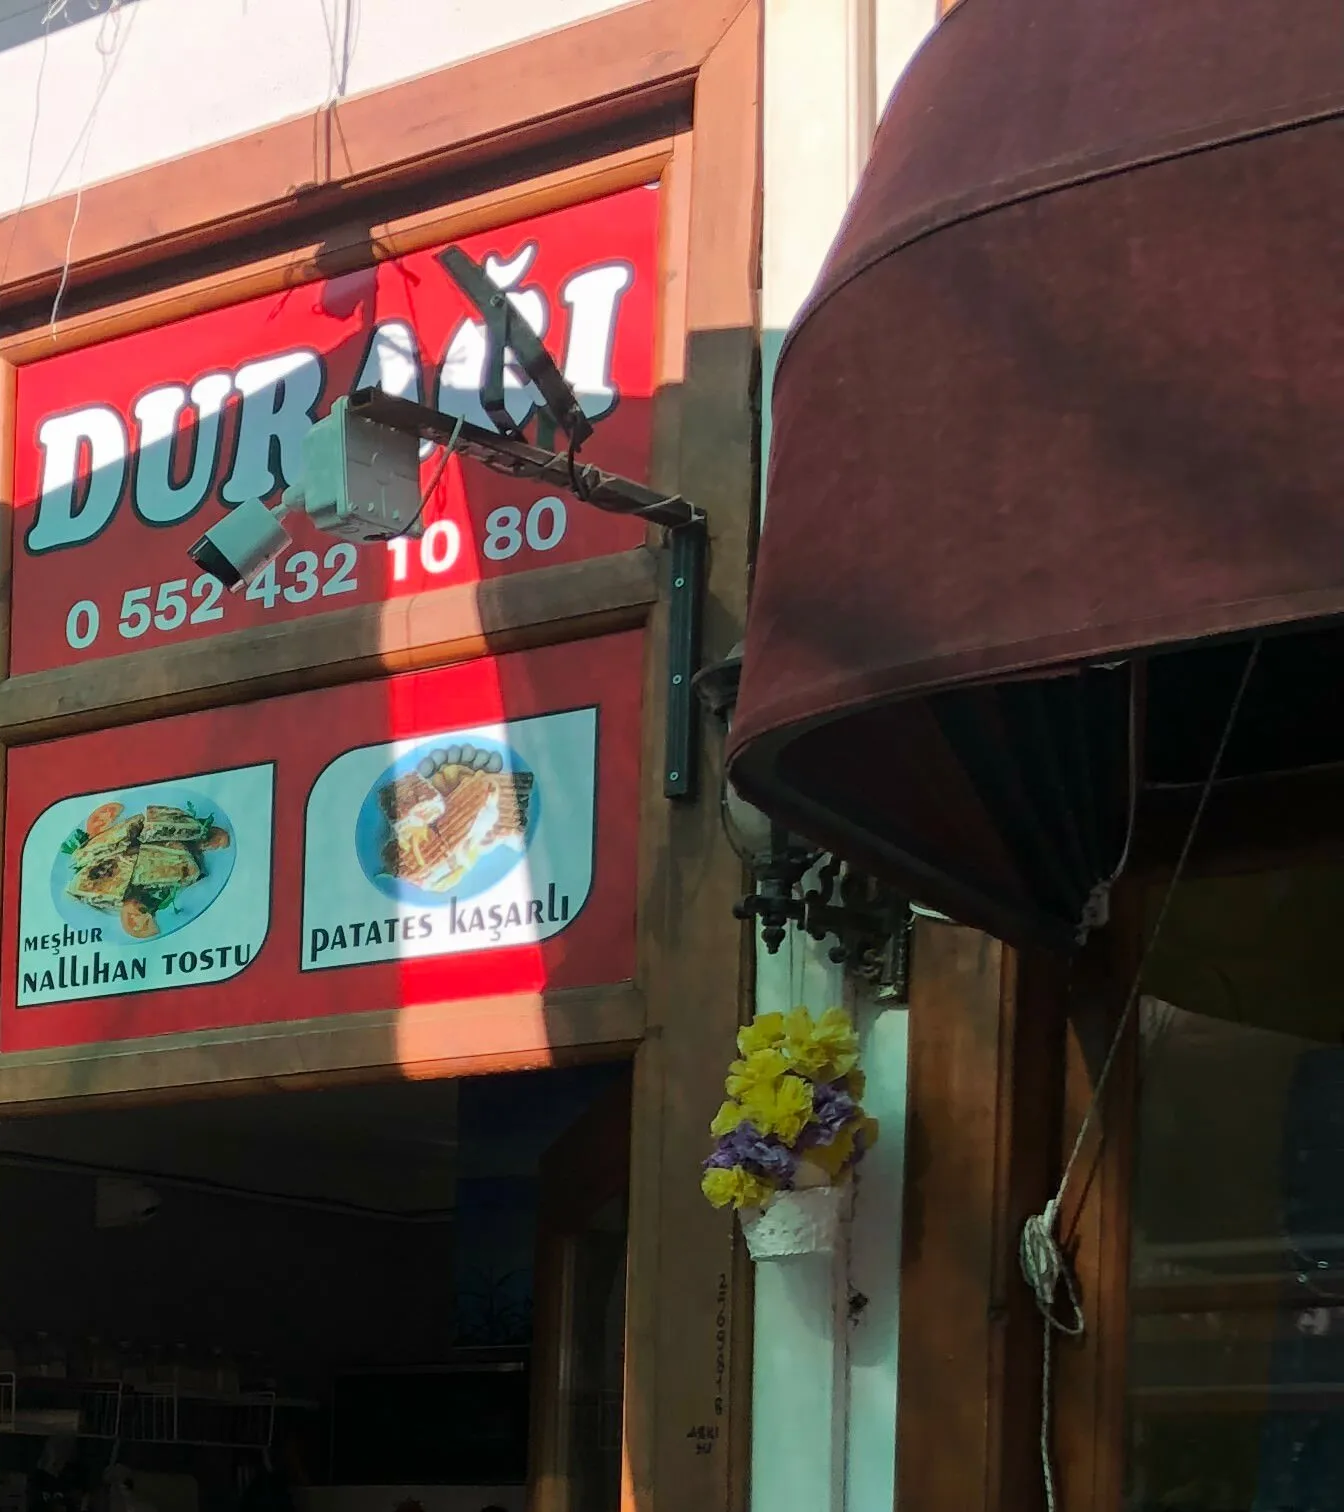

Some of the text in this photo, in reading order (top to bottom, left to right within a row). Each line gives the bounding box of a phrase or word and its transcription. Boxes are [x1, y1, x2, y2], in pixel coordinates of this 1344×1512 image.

[64, 496, 567, 650] 0 552 432 10 80
[23, 924, 104, 956] MEŞHUR
[310, 882, 571, 962] PATATES KAŞARLI
[162, 943, 252, 977] TOSTU
